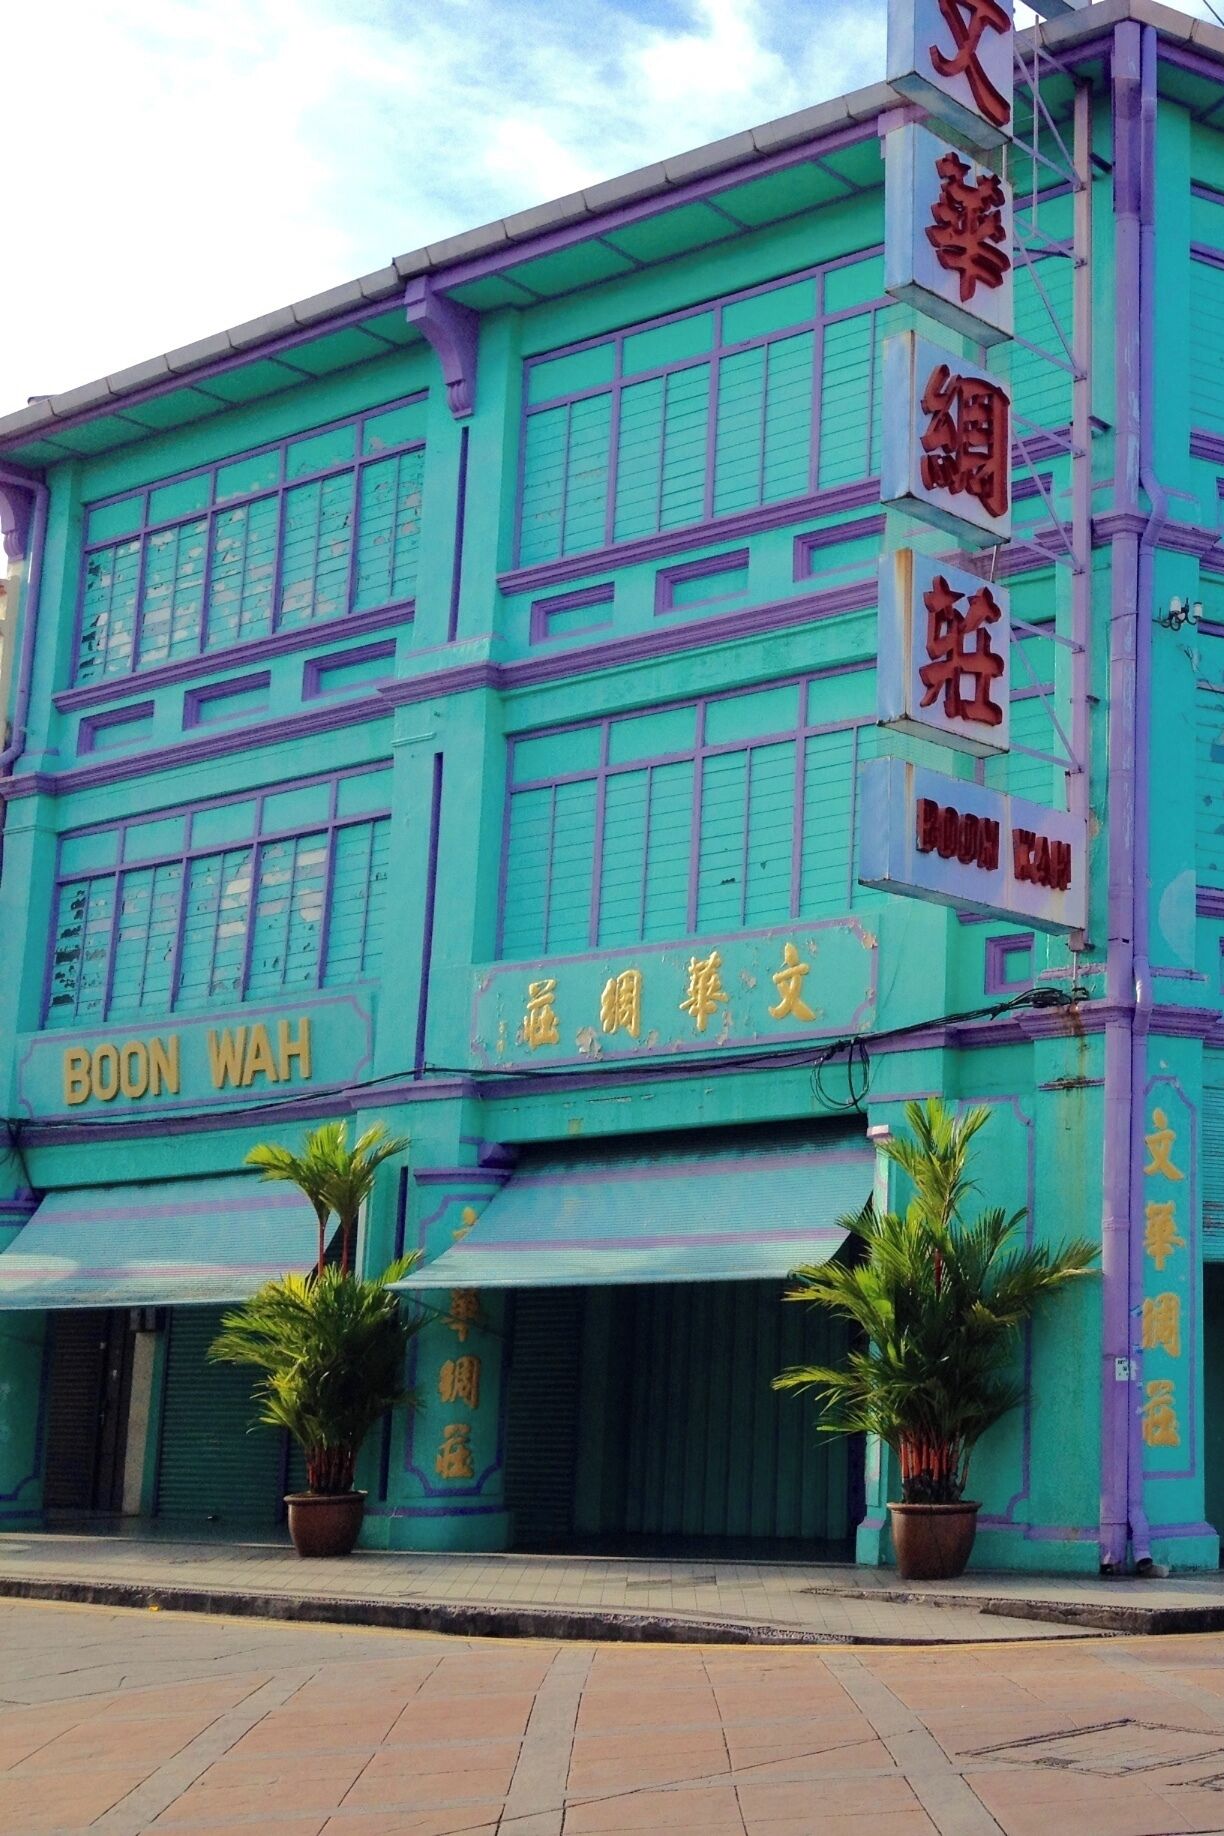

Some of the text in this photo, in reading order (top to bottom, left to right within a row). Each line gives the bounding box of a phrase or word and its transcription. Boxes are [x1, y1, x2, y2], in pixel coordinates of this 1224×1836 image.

[916, 798, 1072, 891] BOON WAH
[64, 1017, 313, 1106] BOON WAH
